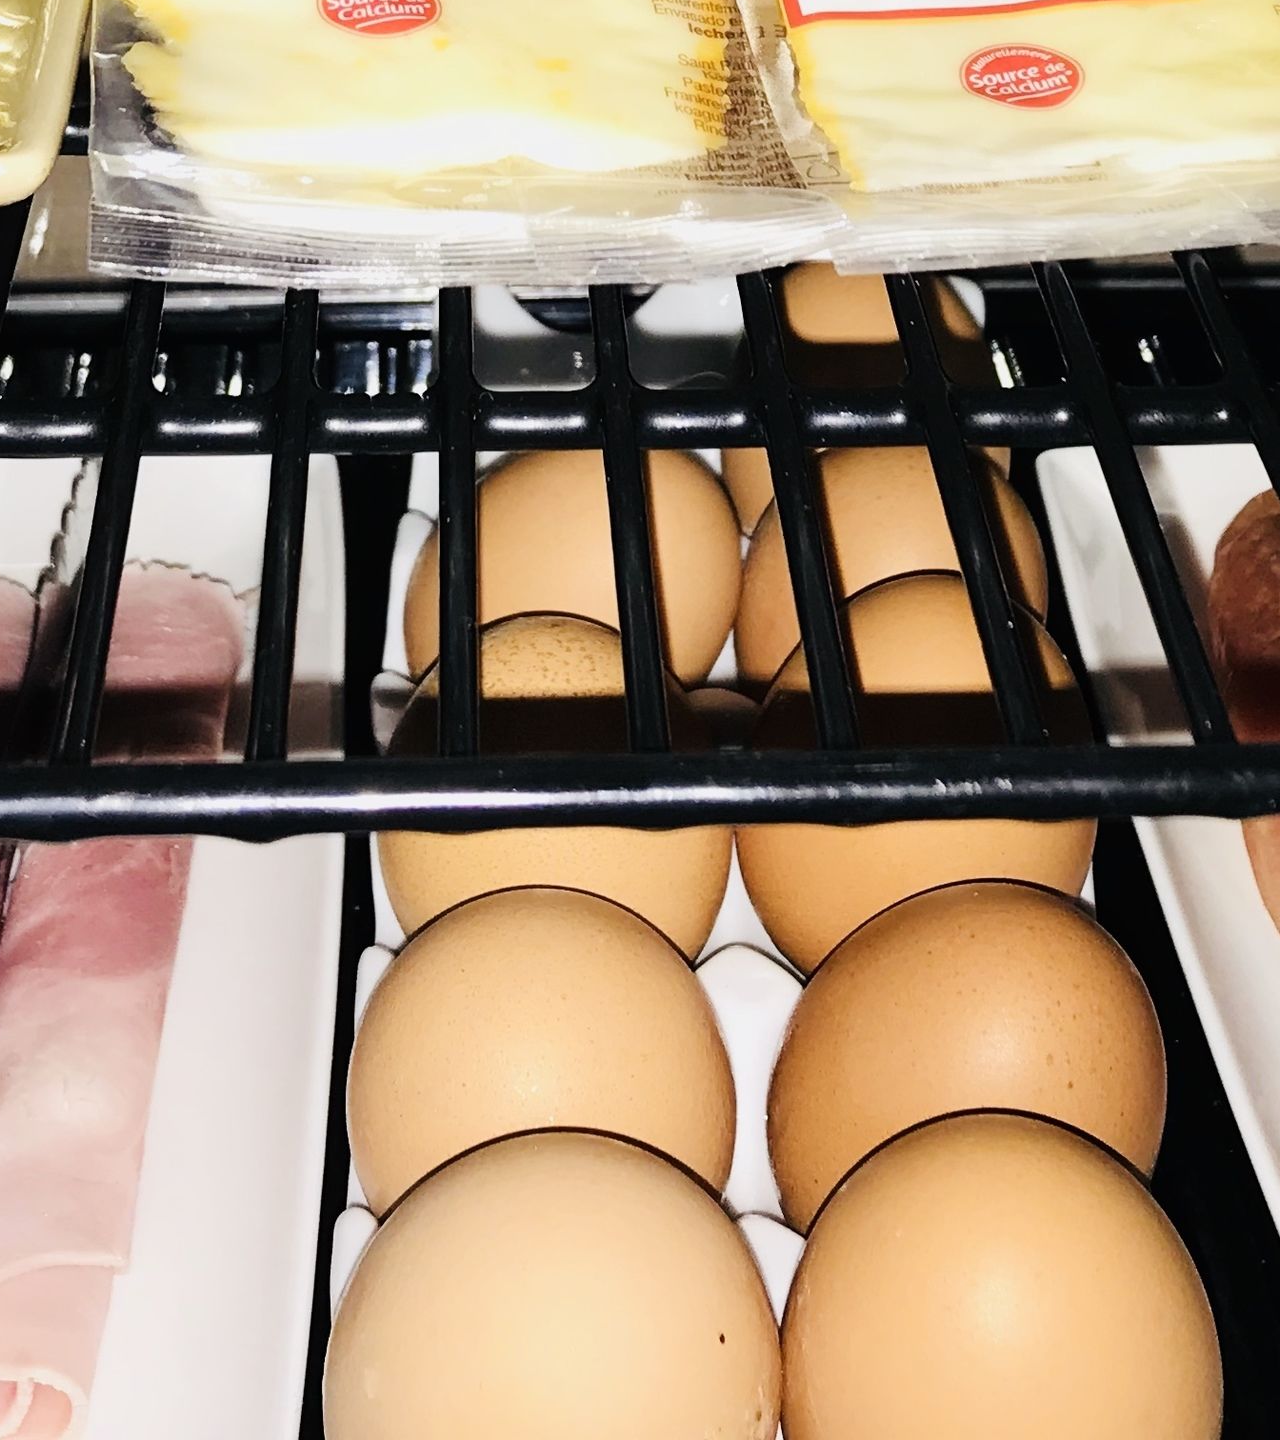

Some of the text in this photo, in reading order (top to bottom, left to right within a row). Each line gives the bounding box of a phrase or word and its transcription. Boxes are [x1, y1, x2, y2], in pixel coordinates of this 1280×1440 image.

[652, 3, 726, 28] Envasado
[969, 61, 1067, 89] Source de
